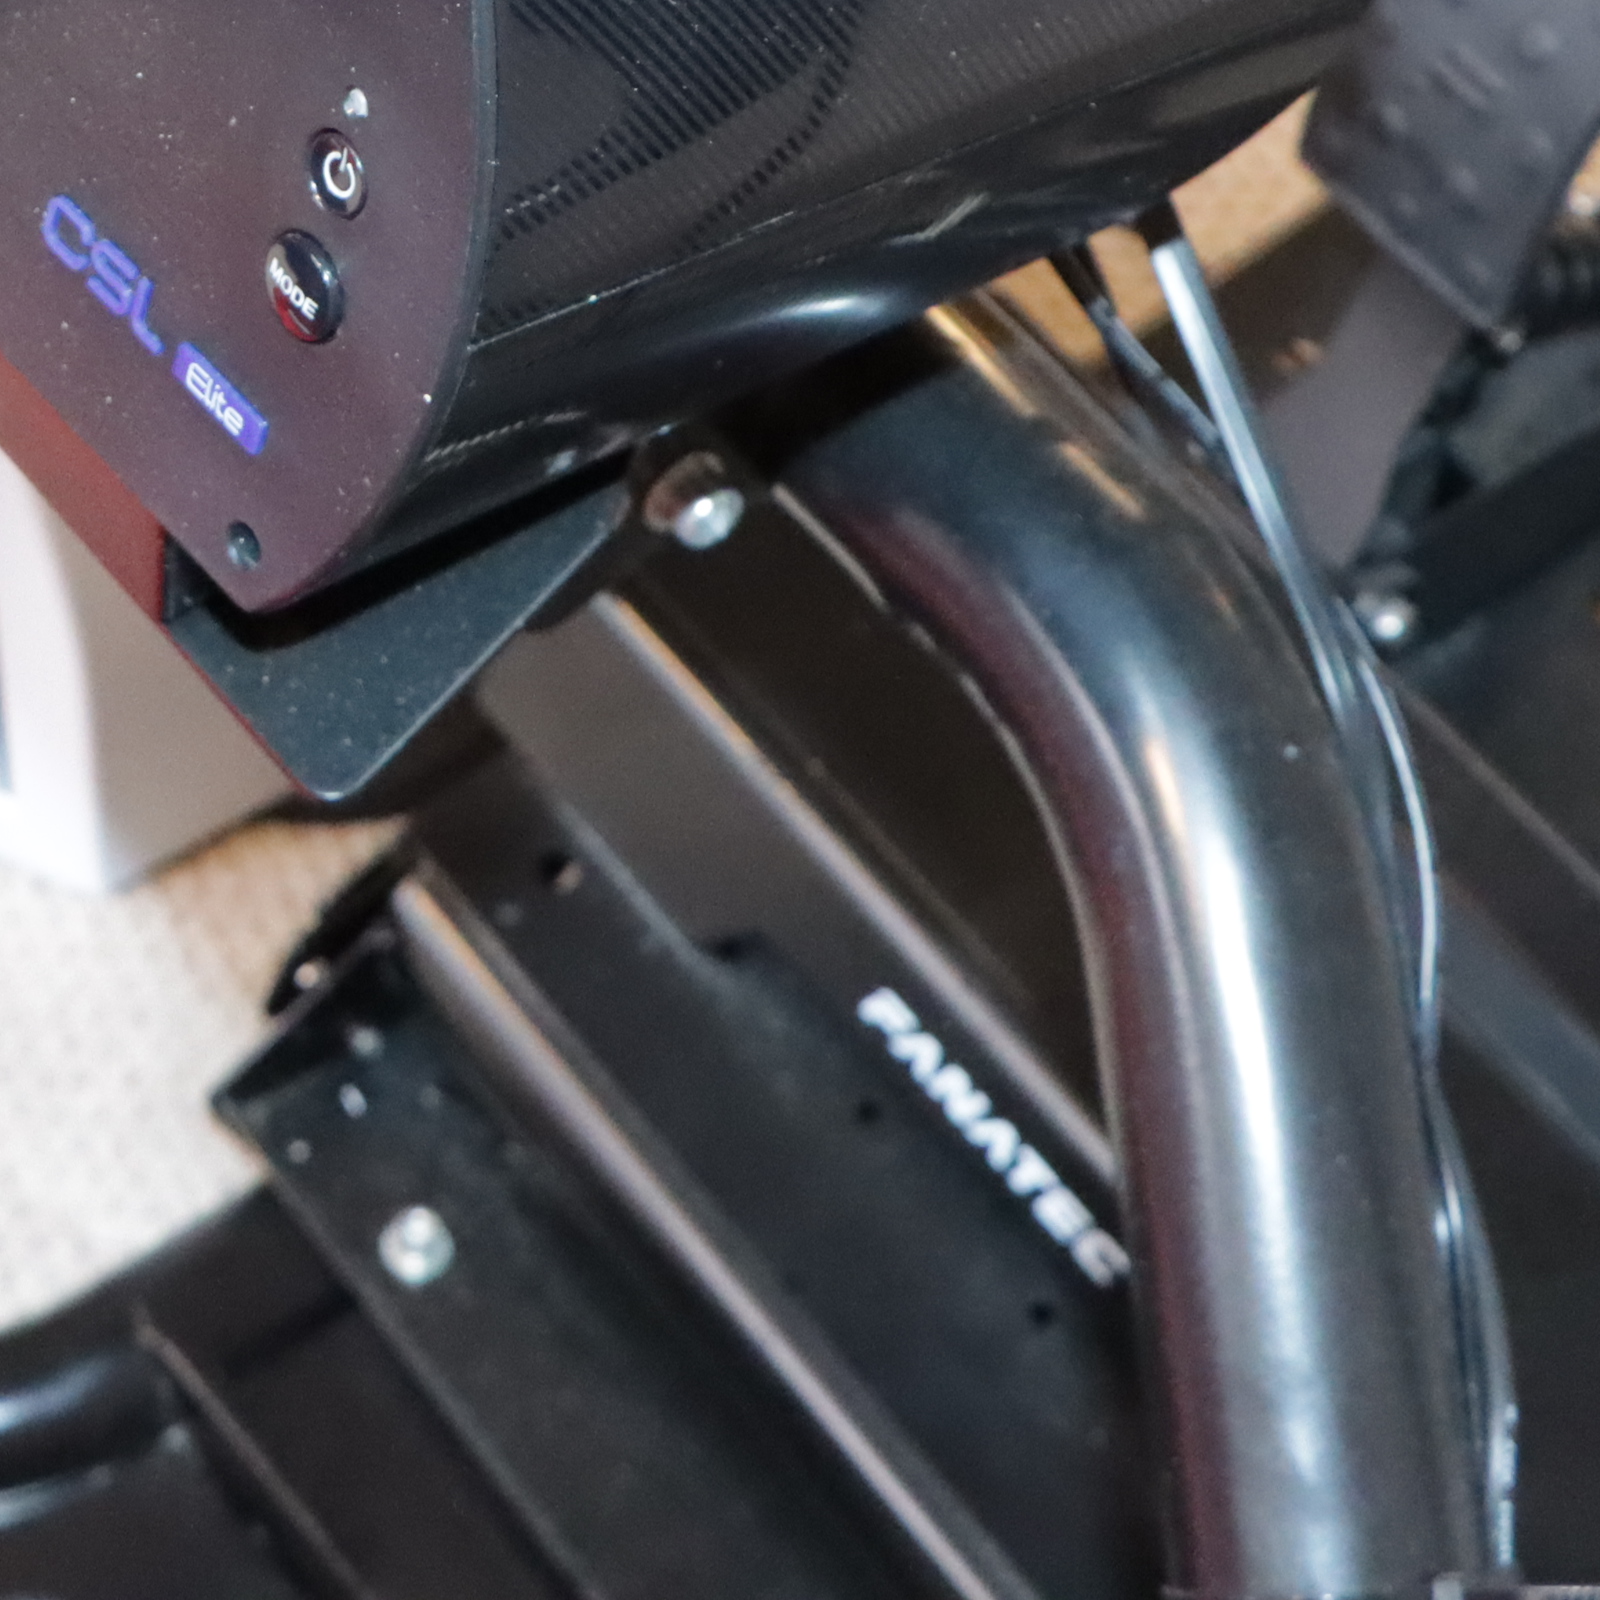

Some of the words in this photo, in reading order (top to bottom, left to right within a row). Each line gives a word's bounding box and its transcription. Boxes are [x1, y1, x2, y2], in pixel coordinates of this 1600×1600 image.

[40, 194, 166, 357] CSL
[184, 361, 245, 437] Elite
[267, 257, 319, 320] MODE
[857, 986, 1131, 1287] FANATEC
